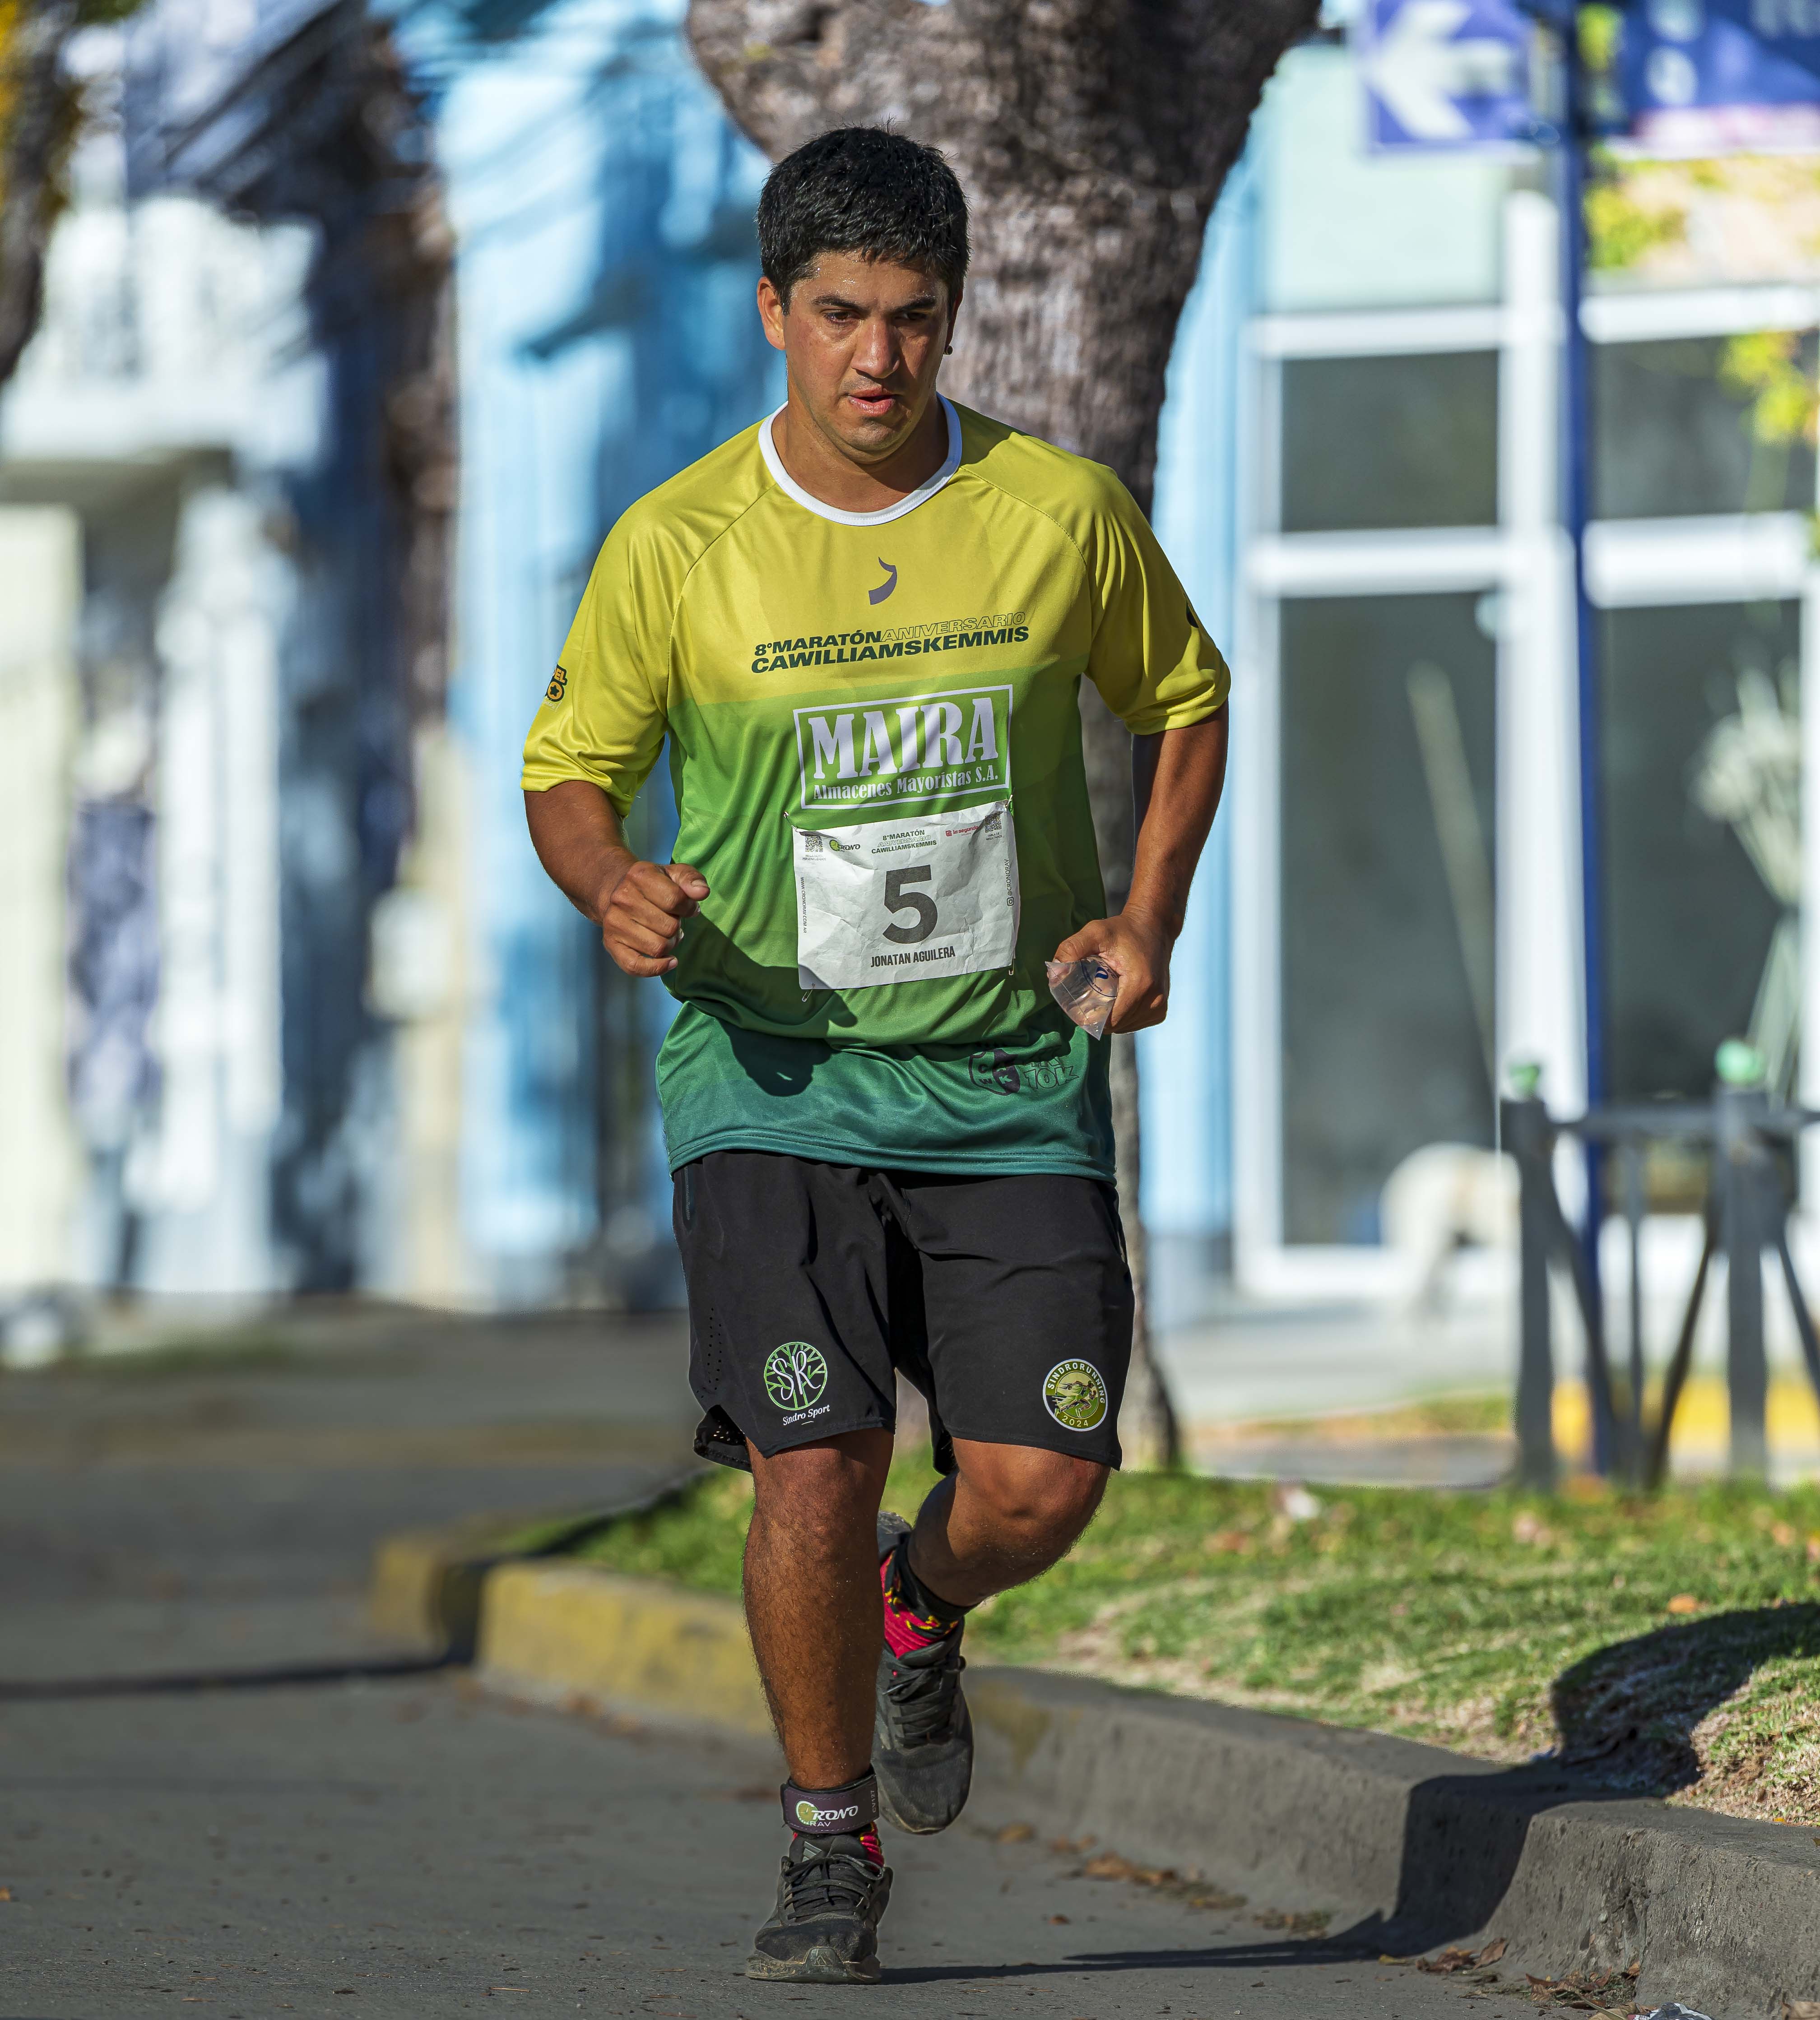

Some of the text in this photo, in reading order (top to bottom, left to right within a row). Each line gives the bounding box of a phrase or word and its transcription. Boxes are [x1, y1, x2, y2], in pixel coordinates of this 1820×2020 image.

[881, 612, 1026, 643] ANIVERSARIO
[751, 626, 1029, 673] CAWILLIAMSKEMMIS
[808, 697, 998, 779] MAIRA
[813, 765, 998, 800] Almacenes Mayoristas S.A.
[871, 840, 937, 854] CAWILLIAMSKEMMIS
[878, 835, 931, 847] ANIVERSARIO
[1004, 859, 1013, 896] @CRONORAV
[882, 864, 938, 944] 5
[871, 945, 955, 968] JONATAN AGUILERA
[1023, 1066, 1079, 1090] 10K
[1047, 1362, 1105, 1404] SINDRORUNNING
[783, 1404, 831, 1426] Sindro Sport
[1062, 1415, 1089, 1427] 2024
